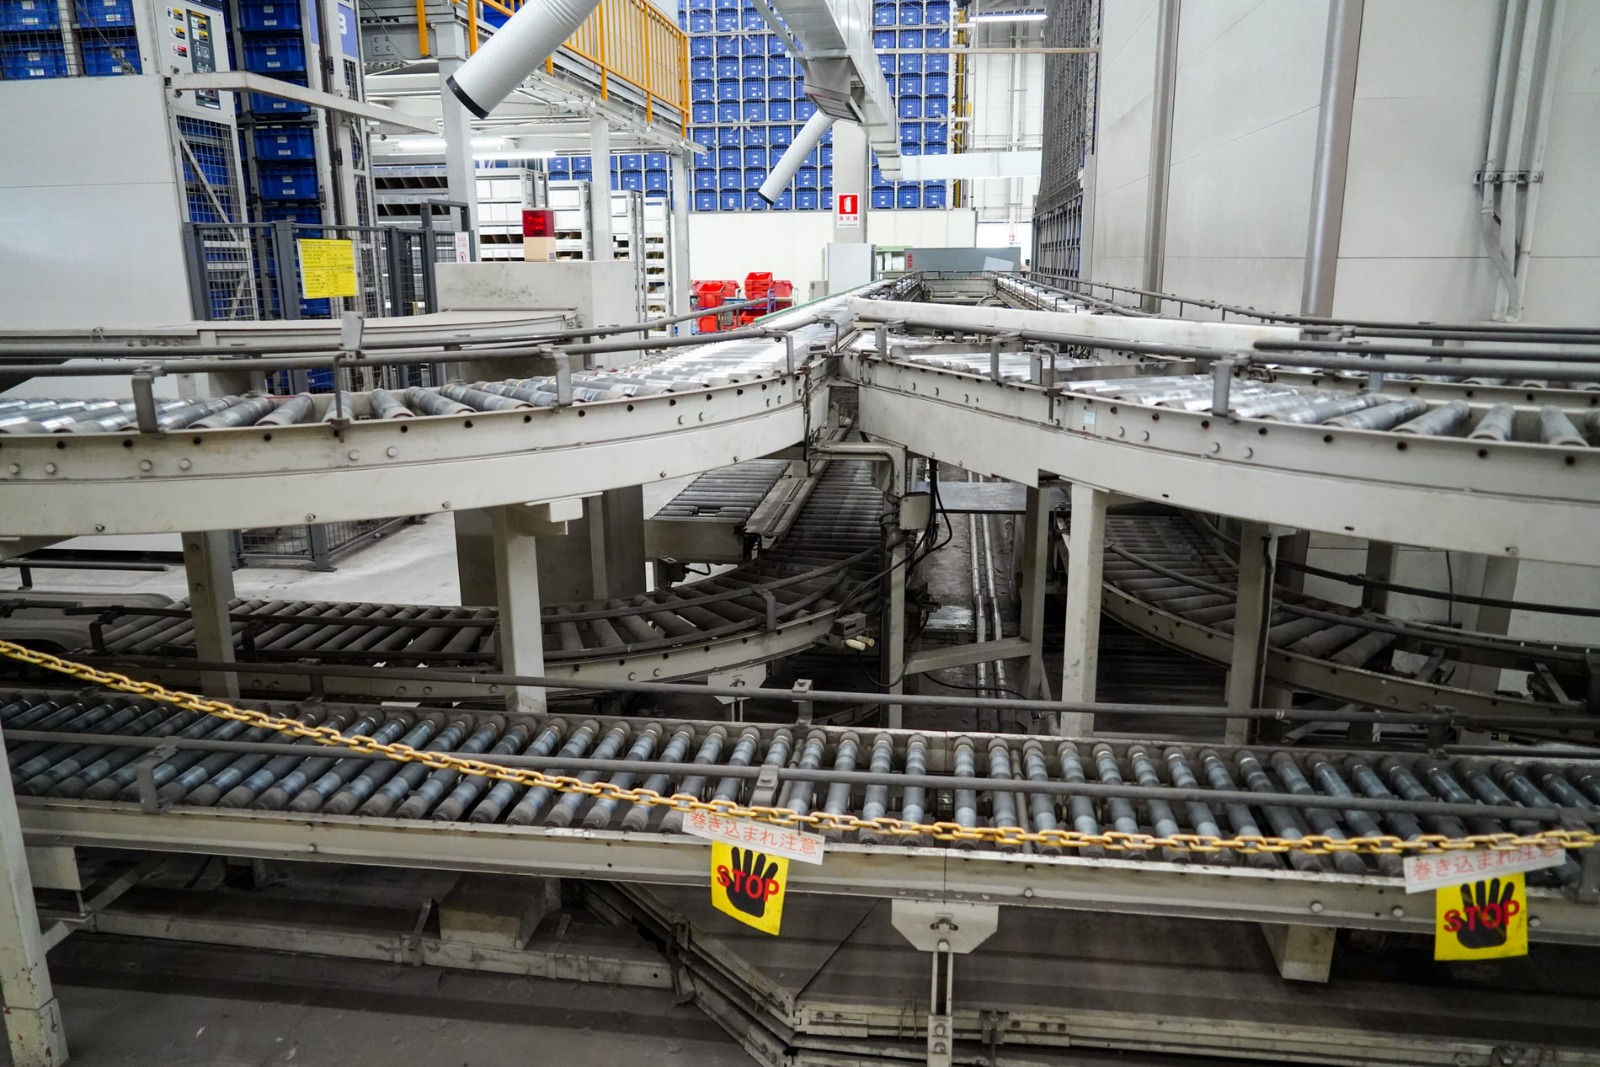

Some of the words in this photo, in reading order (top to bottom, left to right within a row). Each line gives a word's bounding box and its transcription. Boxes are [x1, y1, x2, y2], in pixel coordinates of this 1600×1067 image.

[690, 810, 818, 855] 巻き込まれ注意
[717, 865, 779, 902] STOP
[1443, 900, 1520, 932] STOP
